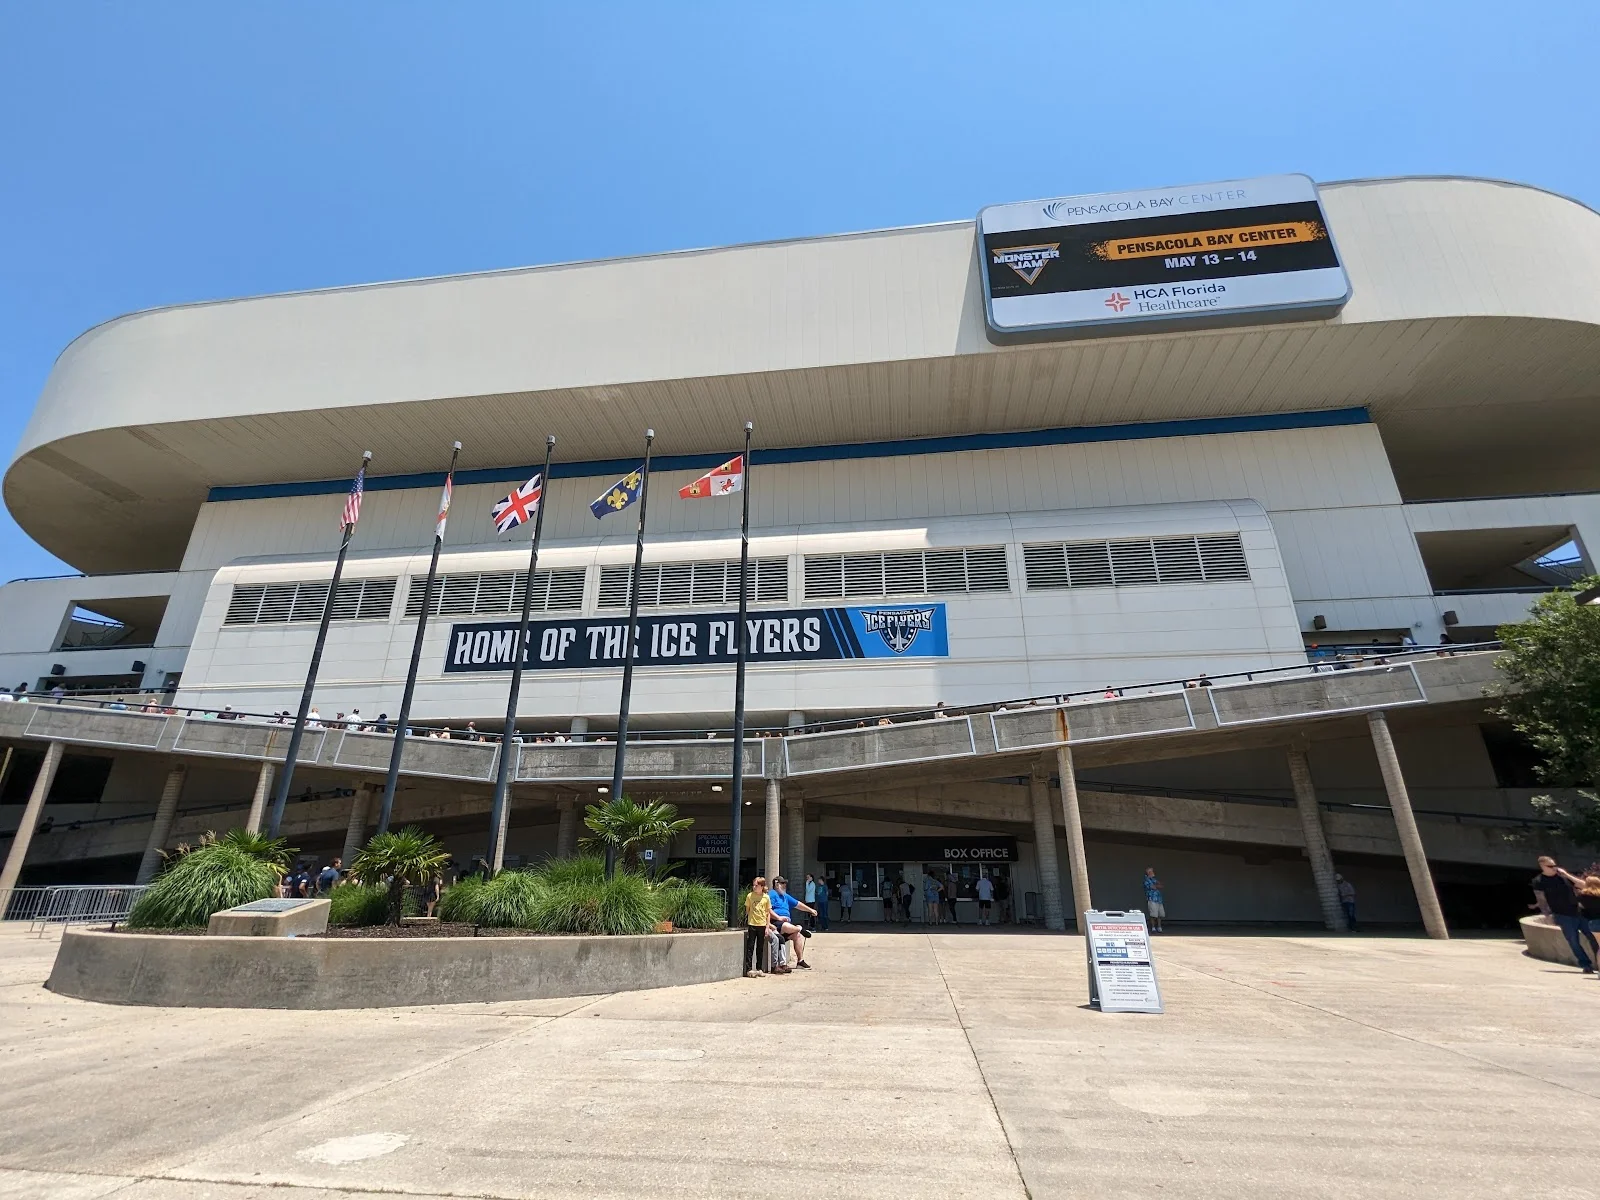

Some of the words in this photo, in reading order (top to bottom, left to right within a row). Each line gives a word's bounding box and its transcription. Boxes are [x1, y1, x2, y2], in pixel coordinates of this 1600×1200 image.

[1067, 201, 1146, 217] PENSACOLA
[1149, 197, 1174, 208] BAY
[1178, 189, 1247, 205] CENTER
[1117, 237, 1203, 254] PENSACOLA
[1205, 234, 1235, 246] BAY
[1238, 228, 1298, 242] CENTER
[993, 250, 1060, 264] MONSTER
[1013, 260, 1044, 270] JAM
[1164, 255, 1197, 269] MAY
[1201, 253, 1220, 266] 13
[1237, 250, 1258, 262] 14
[1134, 288, 1169, 300] HCA
[1172, 283, 1226, 297] Florida
[539, 627, 577, 662] OF
[650, 622, 698, 658] ICE
[708, 617, 821, 656] FLYERS
[697, 846, 731, 854] ENTRANC
[944, 848, 969, 858] BOX
[970, 848, 1009, 858] OFFICE
